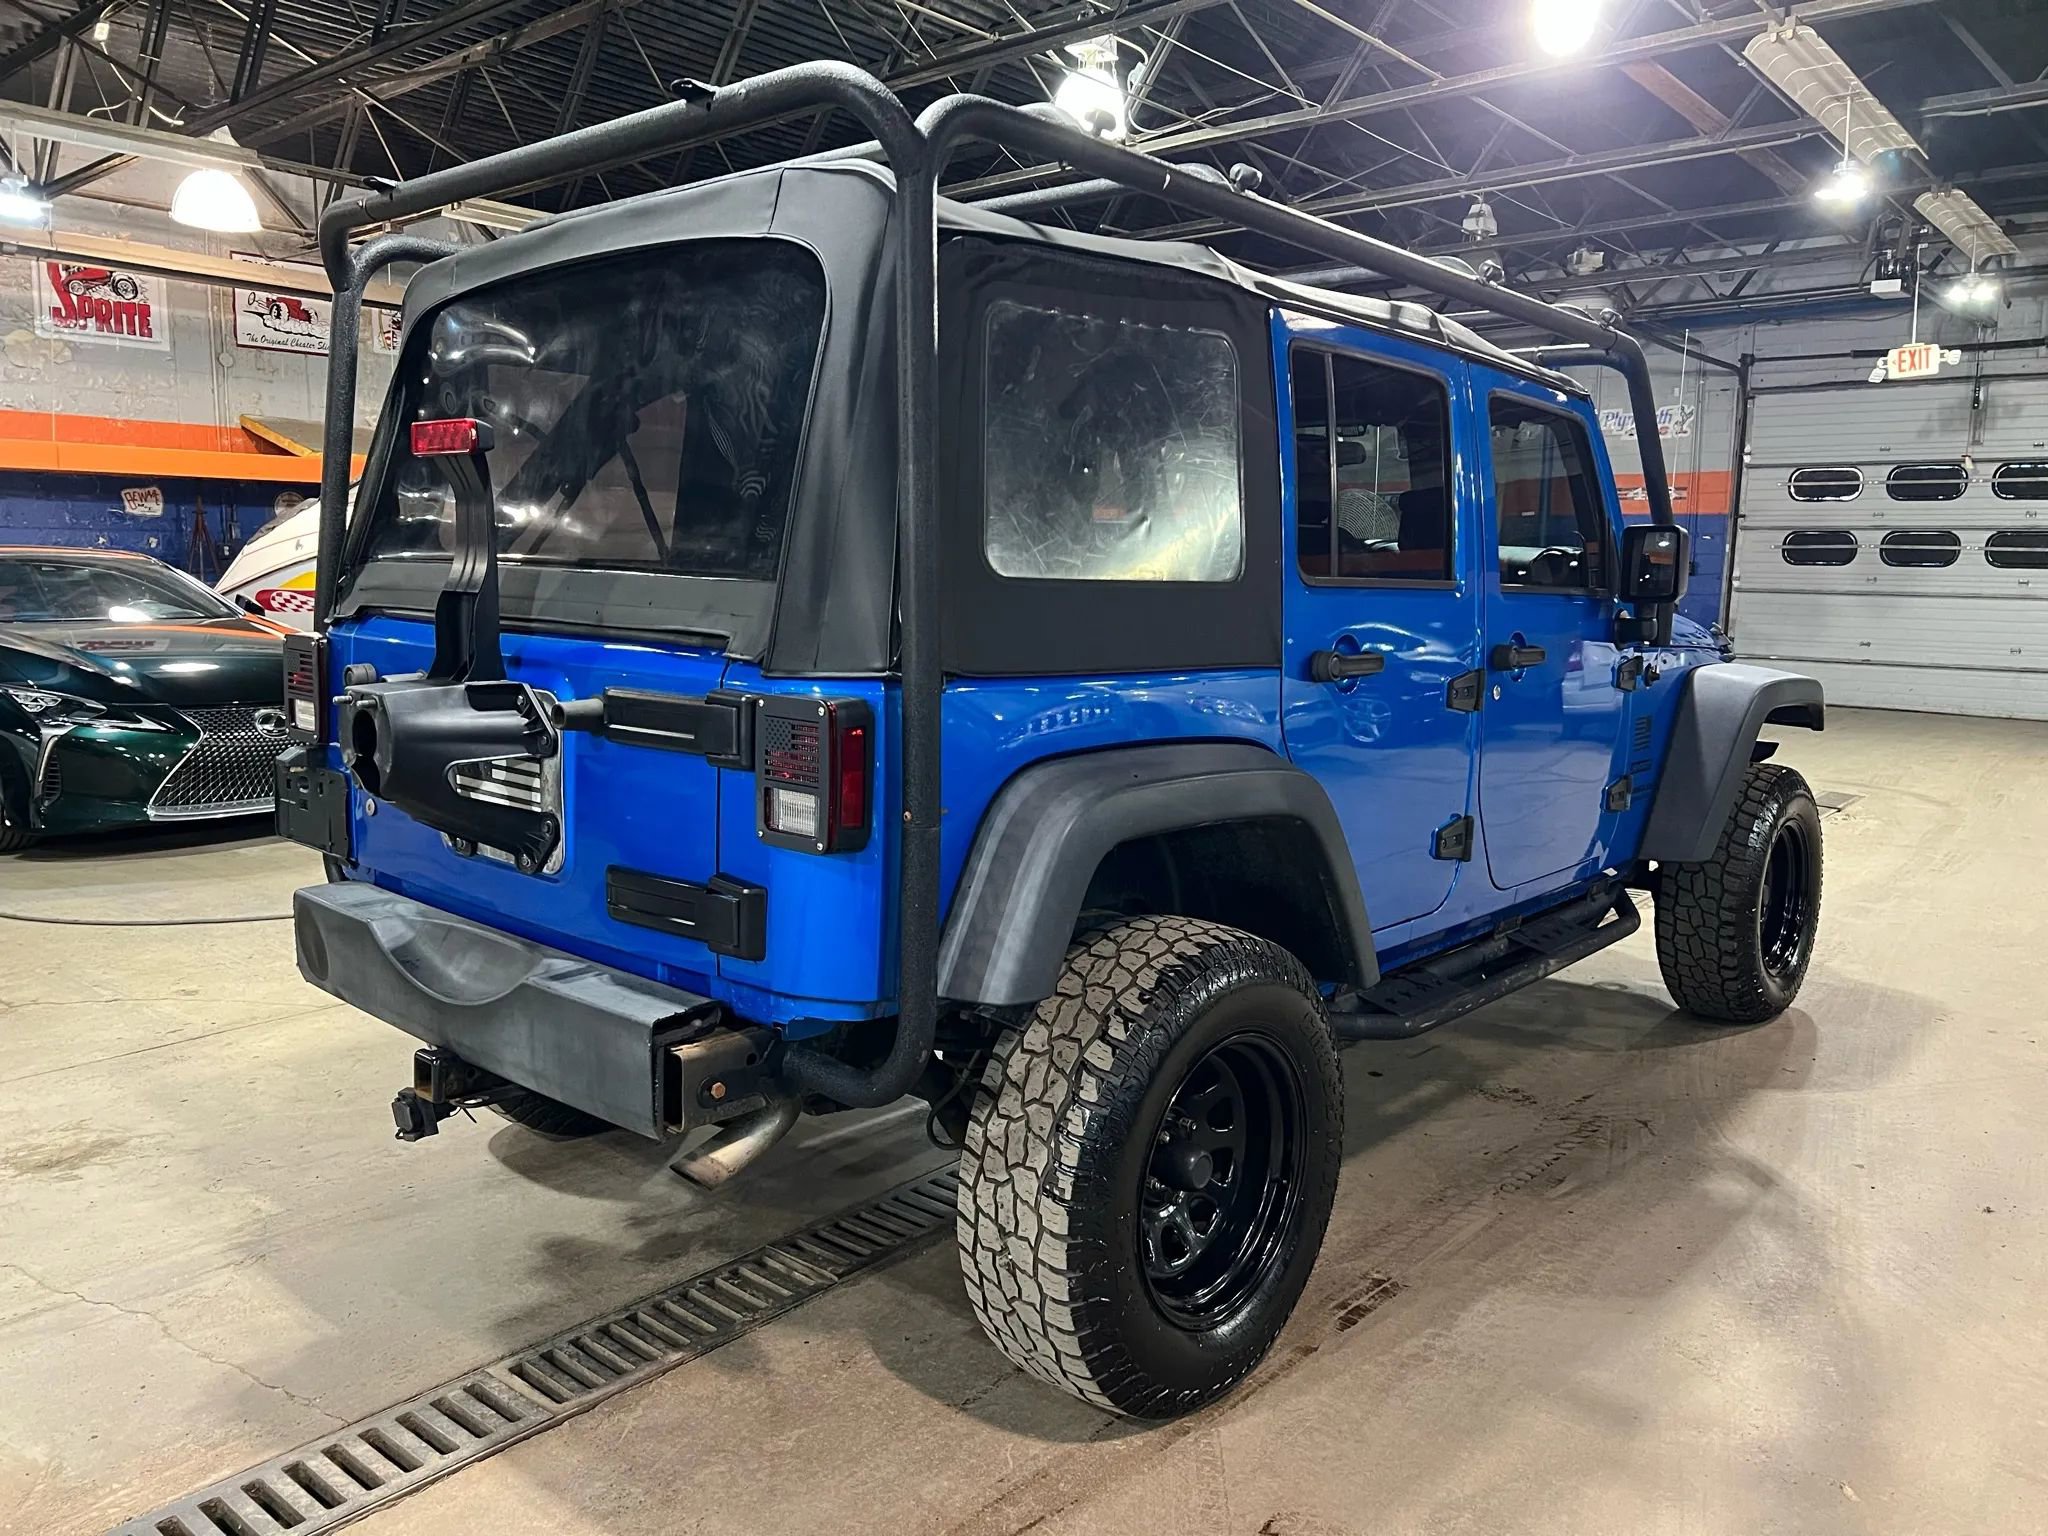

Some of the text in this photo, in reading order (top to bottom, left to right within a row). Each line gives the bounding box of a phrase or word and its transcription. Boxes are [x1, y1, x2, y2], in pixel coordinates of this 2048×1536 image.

[47, 262, 153, 338] SPRITE
[246, 332, 258, 343] The
[260, 334, 289, 346] Original
[1898, 347, 1931, 373] EXIT
